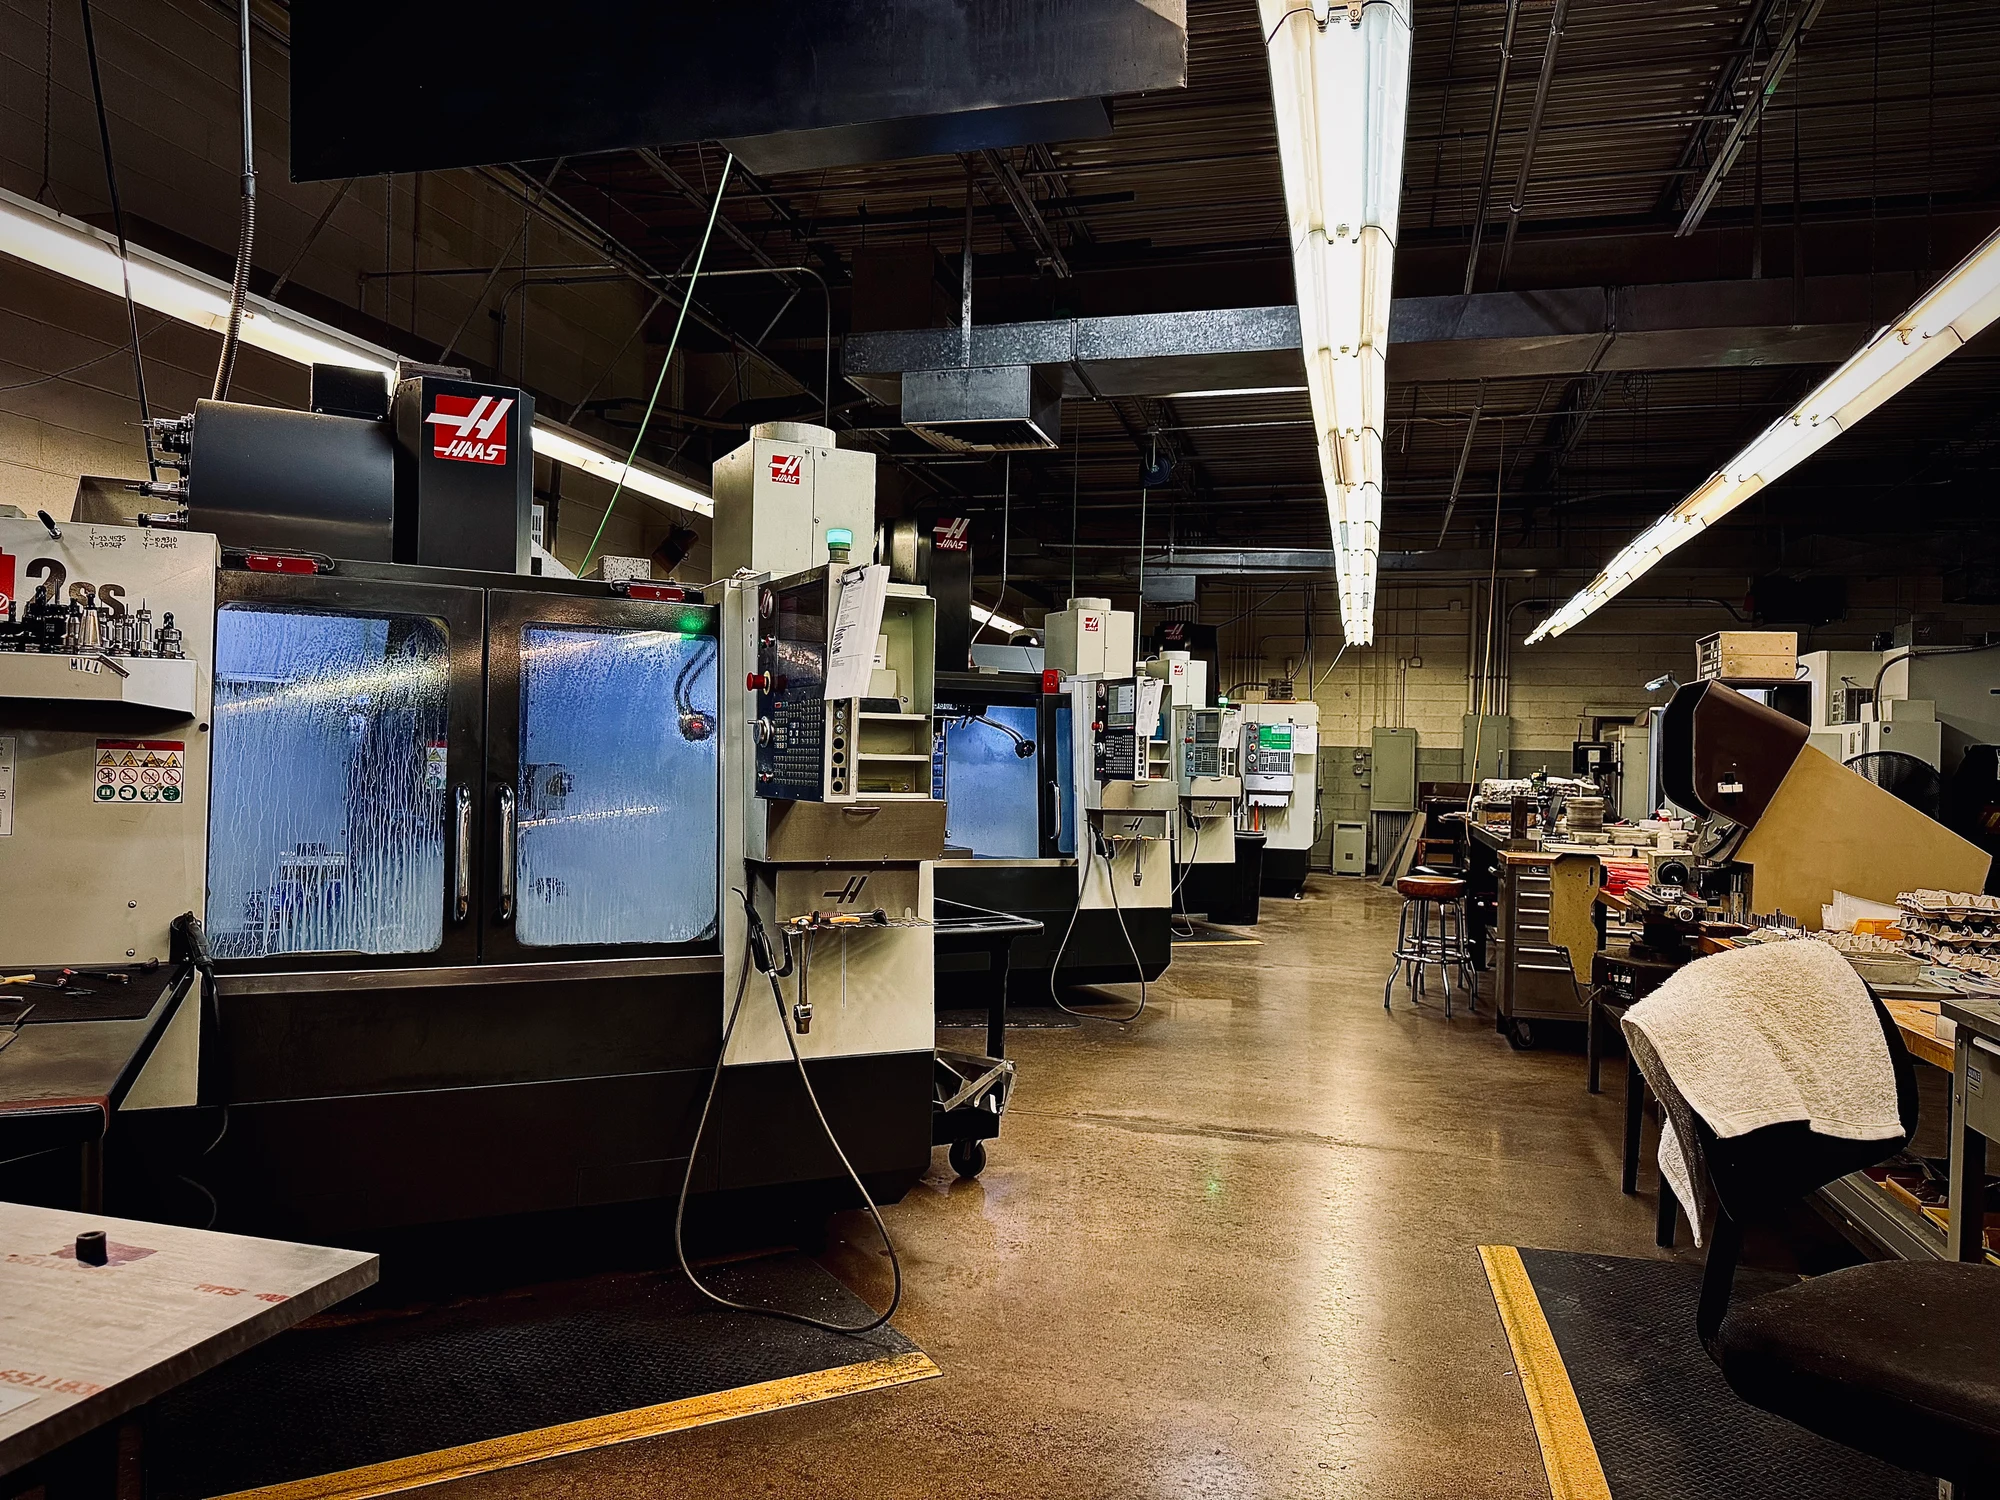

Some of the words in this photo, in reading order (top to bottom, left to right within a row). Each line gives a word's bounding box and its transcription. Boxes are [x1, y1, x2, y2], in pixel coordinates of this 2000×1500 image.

[434, 440, 507, 461] HAAS
[772, 473, 800, 483] HAAS
[936, 539, 967, 549] HAAS
[70, 658, 100, 674] MILL
